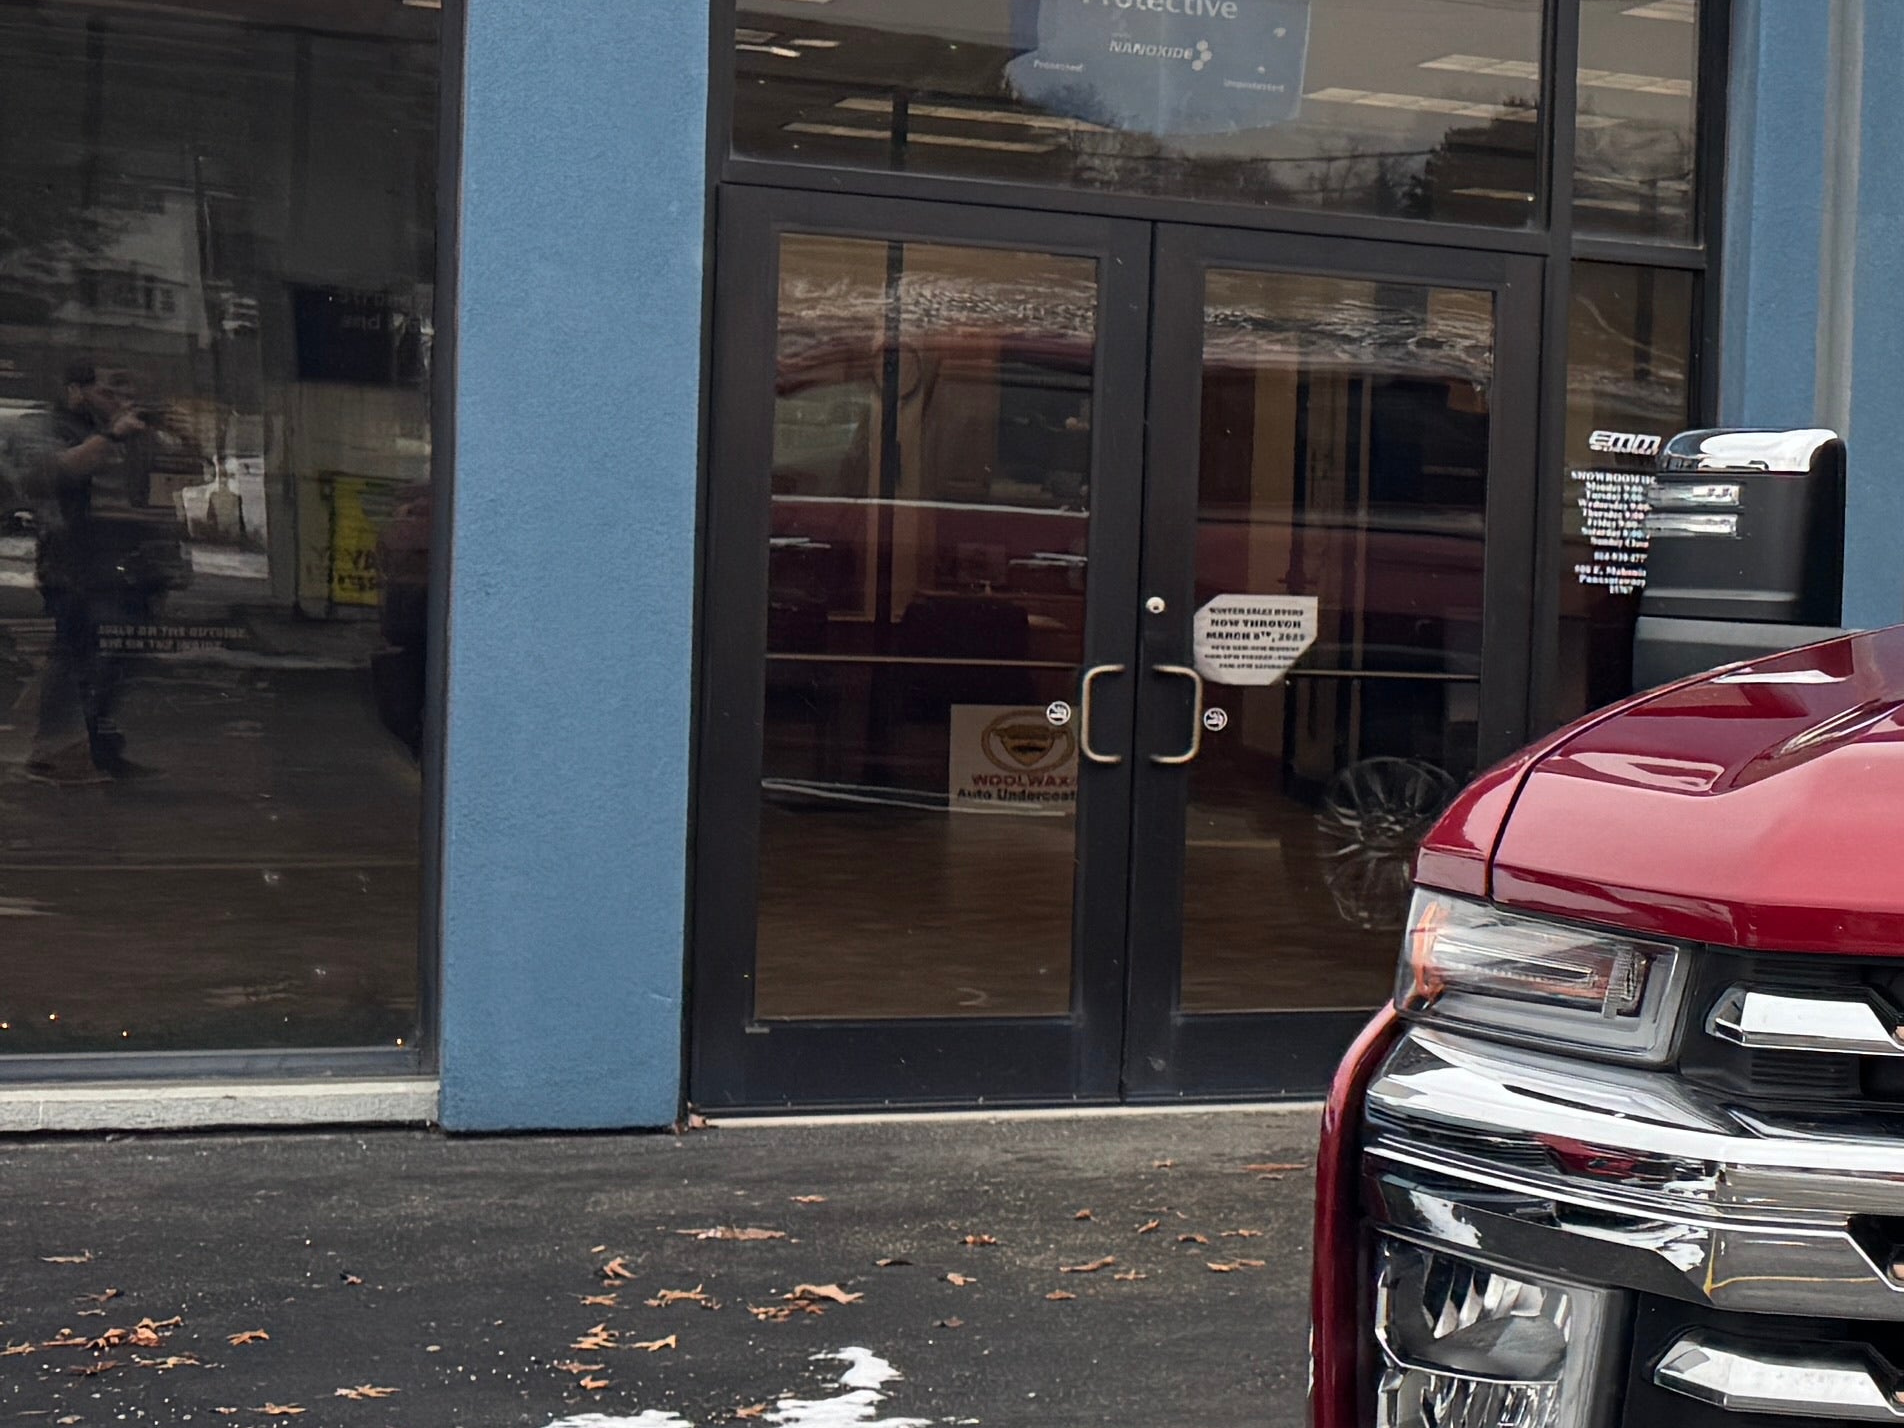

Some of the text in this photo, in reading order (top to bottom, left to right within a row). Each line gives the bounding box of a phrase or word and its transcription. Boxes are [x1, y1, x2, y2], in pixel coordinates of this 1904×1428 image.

[1109, 39, 1194, 60] NANOXIDE
[1211, 619, 1301, 628] NOW THROUGH
[1206, 631, 1250, 640] MARCH
[972, 773, 1069, 787] WOOLWAX
[957, 788, 992, 801] Auto
